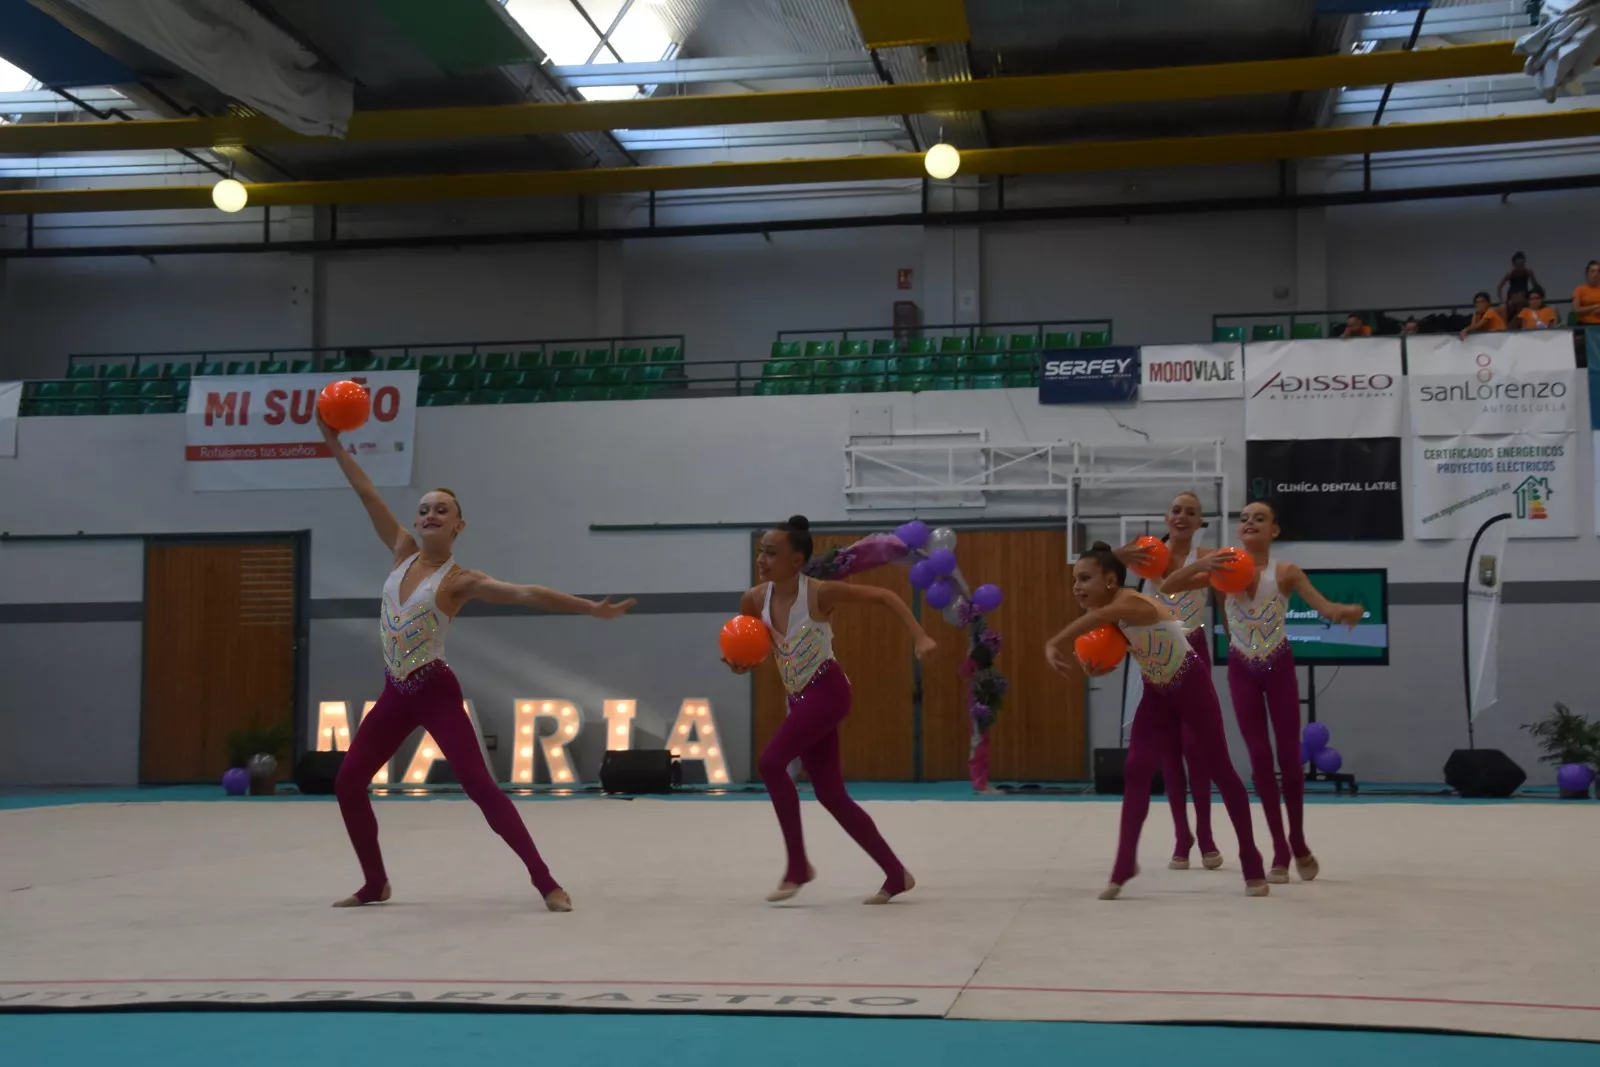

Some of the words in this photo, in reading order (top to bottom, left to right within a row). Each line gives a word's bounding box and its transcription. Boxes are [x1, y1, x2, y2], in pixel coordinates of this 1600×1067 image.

[1044, 358, 1132, 376] SERFEY
[1149, 360, 1235, 383] MODOVIAJE
[1250, 371, 1394, 399] ADISSEO
[1420, 380, 1567, 402] sanLorenzo
[204, 391, 252, 427] MI
[263, 377, 401, 426] SUO
[1482, 403, 1567, 414] AUTOESCUELA
[200, 446, 257, 458] Rotulamos
[260, 447, 277, 457] tus
[1424, 447, 1494, 460] CERTIFICADOS
[1437, 460, 1494, 474] PROYECTOS
[1321, 482, 1363, 493] DENTAL
[1365, 481, 1398, 492] LATRE
[1285, 609, 1318, 619] nfantil
